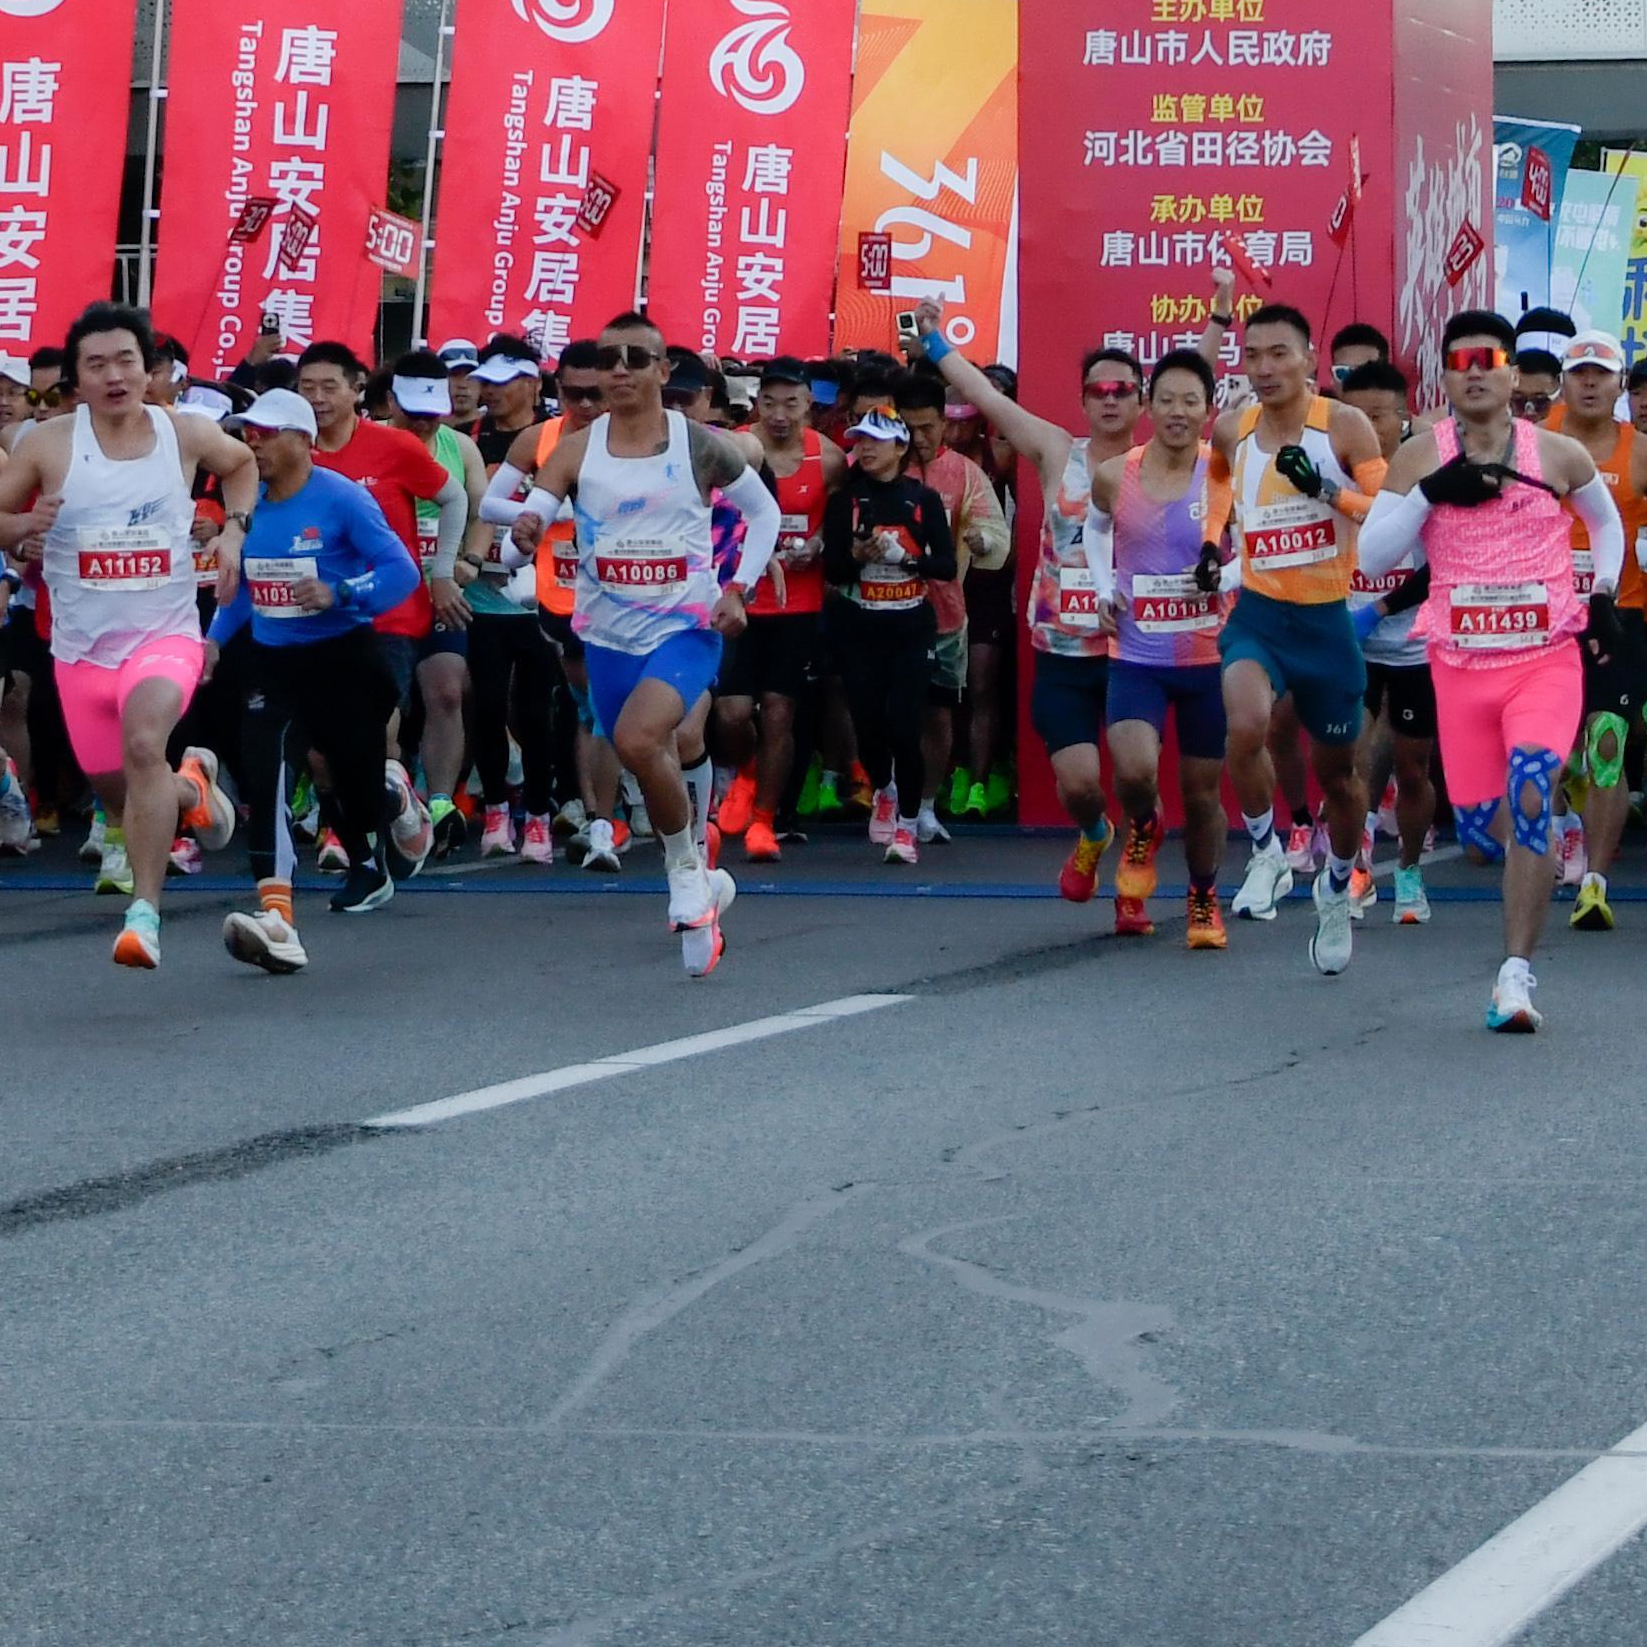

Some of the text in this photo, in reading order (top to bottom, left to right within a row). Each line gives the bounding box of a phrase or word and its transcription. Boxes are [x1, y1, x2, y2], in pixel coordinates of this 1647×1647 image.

[1083, 29, 1332, 67] 唐山市人民政府
[231, 20, 265, 151] Tangshan
[1150, 94, 1264, 123] 监管单位
[1083, 129, 1332, 167] 河北省田径协会
[225, 156, 253, 218] Anju
[485, 70, 533, 326] Tangshan Anju Group
[706, 140, 732, 247] Tangshan
[1150, 194, 1264, 223] 承办单位
[365, 214, 415, 265] 5:00
[701, 252, 724, 304] Anju
[860, 242, 888, 278] 5:00
[1150, 293, 1264, 323] 协办位
[1254, 528, 1328, 555] A10012
[89, 556, 162, 575] A11152
[606, 564, 678, 580] A10086
[253, 587, 296, 603] A103
[1459, 610, 1538, 631] A11439
